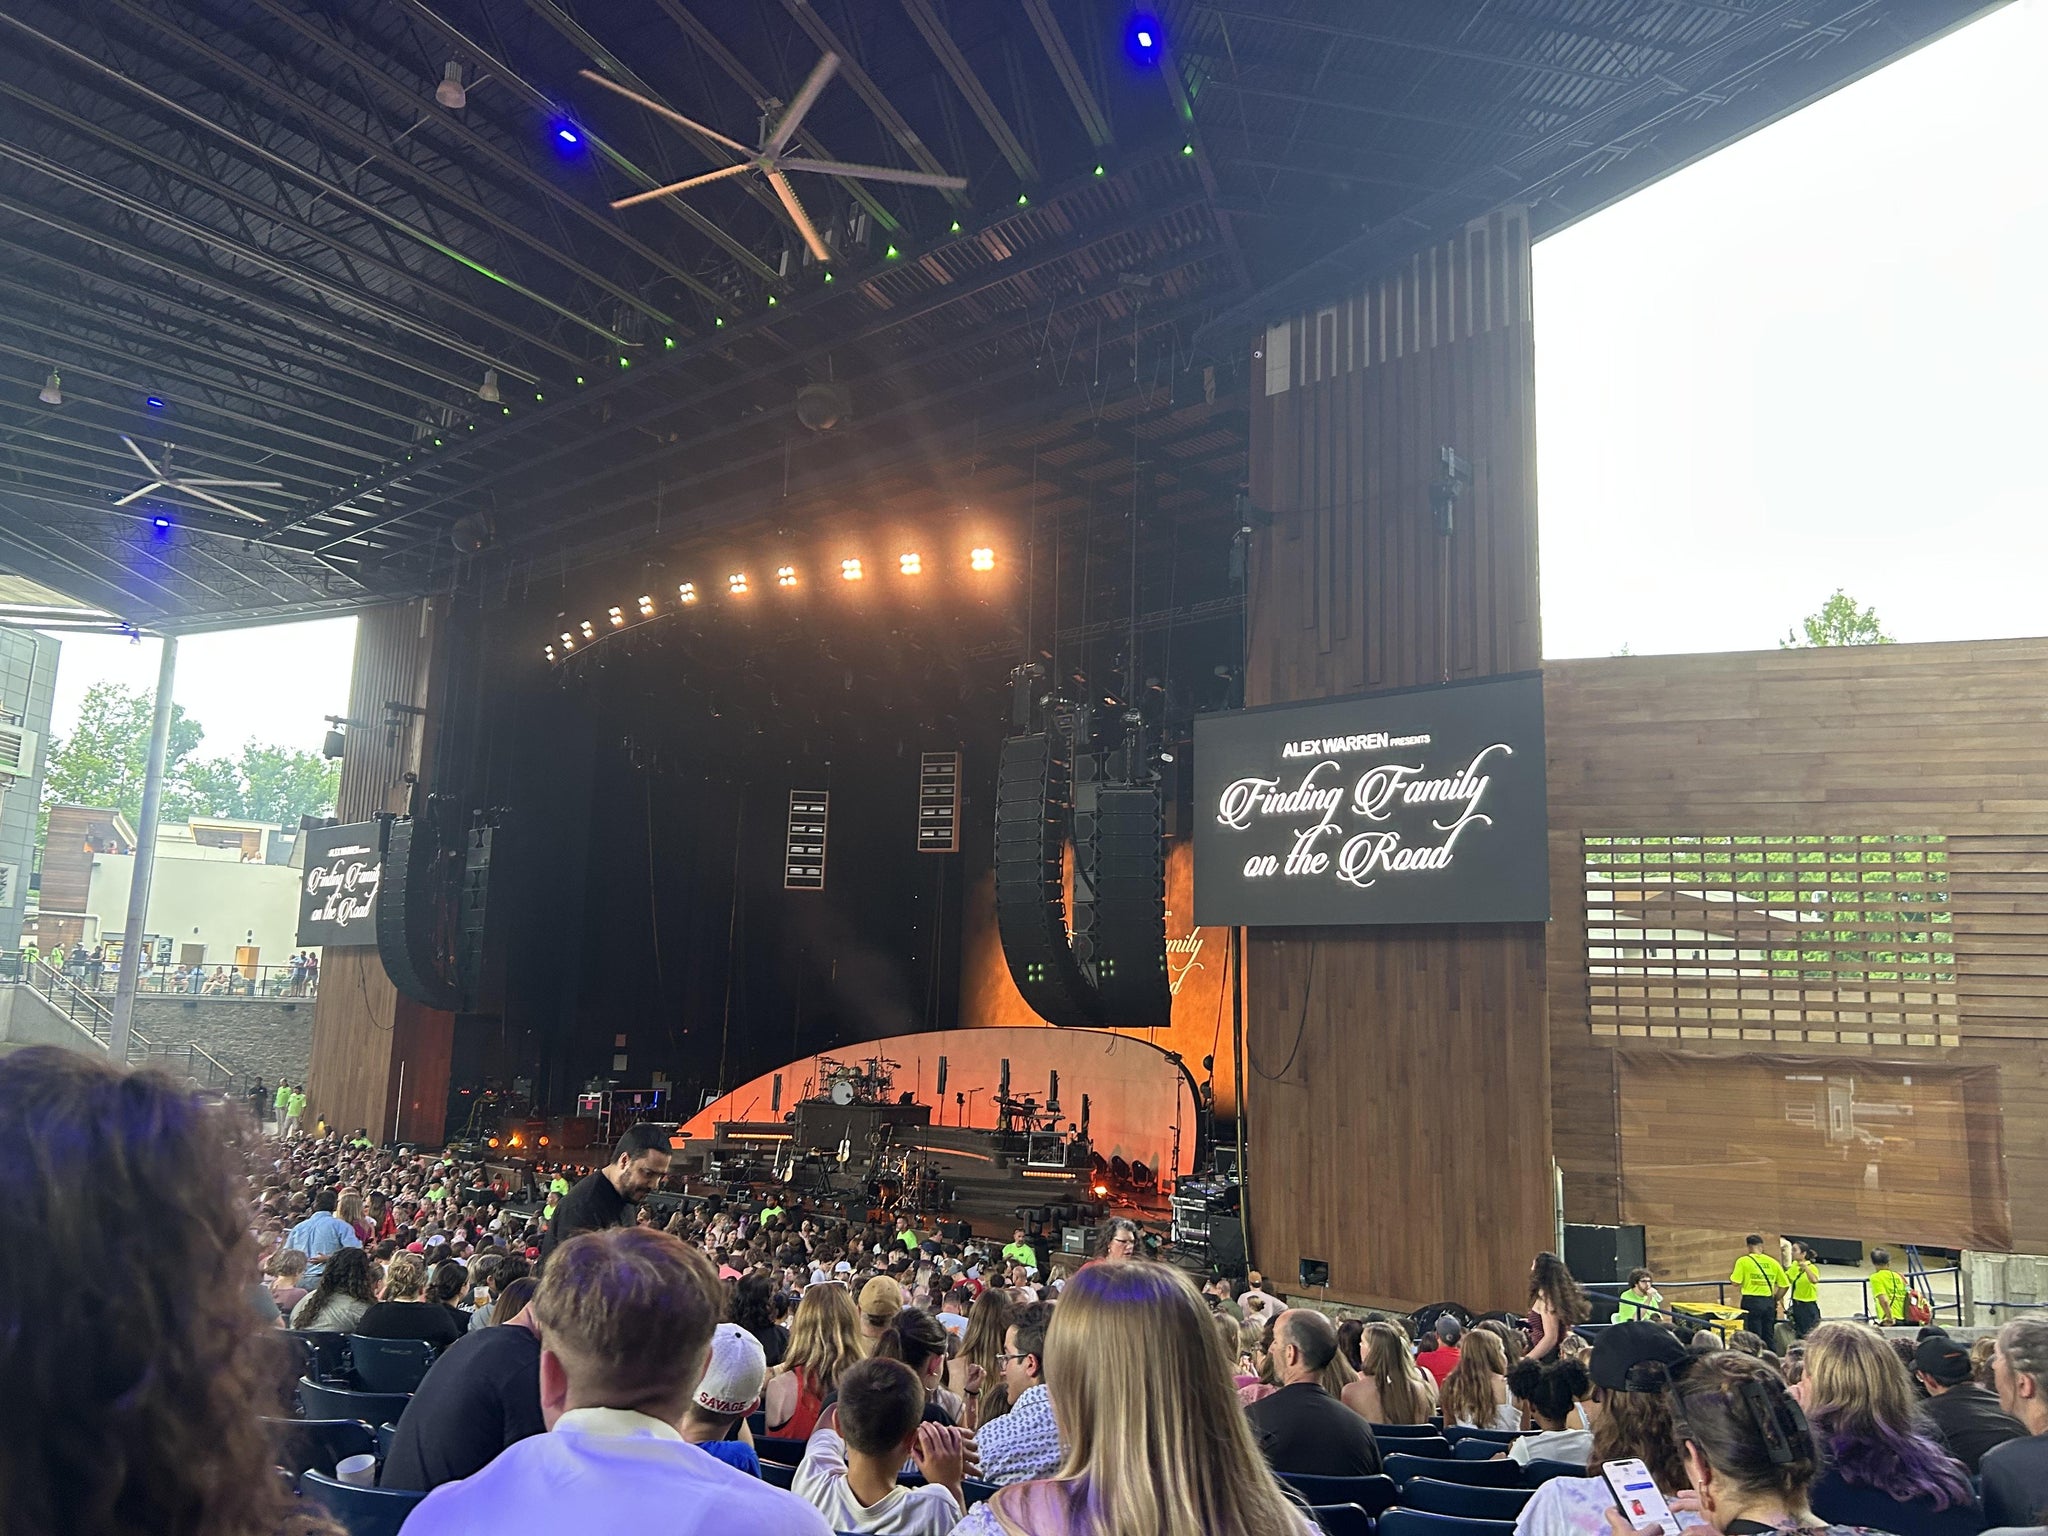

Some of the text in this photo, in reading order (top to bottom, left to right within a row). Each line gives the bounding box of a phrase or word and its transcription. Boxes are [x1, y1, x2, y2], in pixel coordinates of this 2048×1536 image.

[1282, 732, 1431, 758] ALEX WARREN PRESENTS
[1216, 743, 1513, 838] Finding Family
[1243, 814, 1492, 888] on the Road
[306, 859, 345, 897] Finding
[323, 893, 342, 921] the
[336, 890, 377, 927] Road
[1166, 926, 1203, 971] mily
[700, 1391, 746, 1411] SAVAGE
